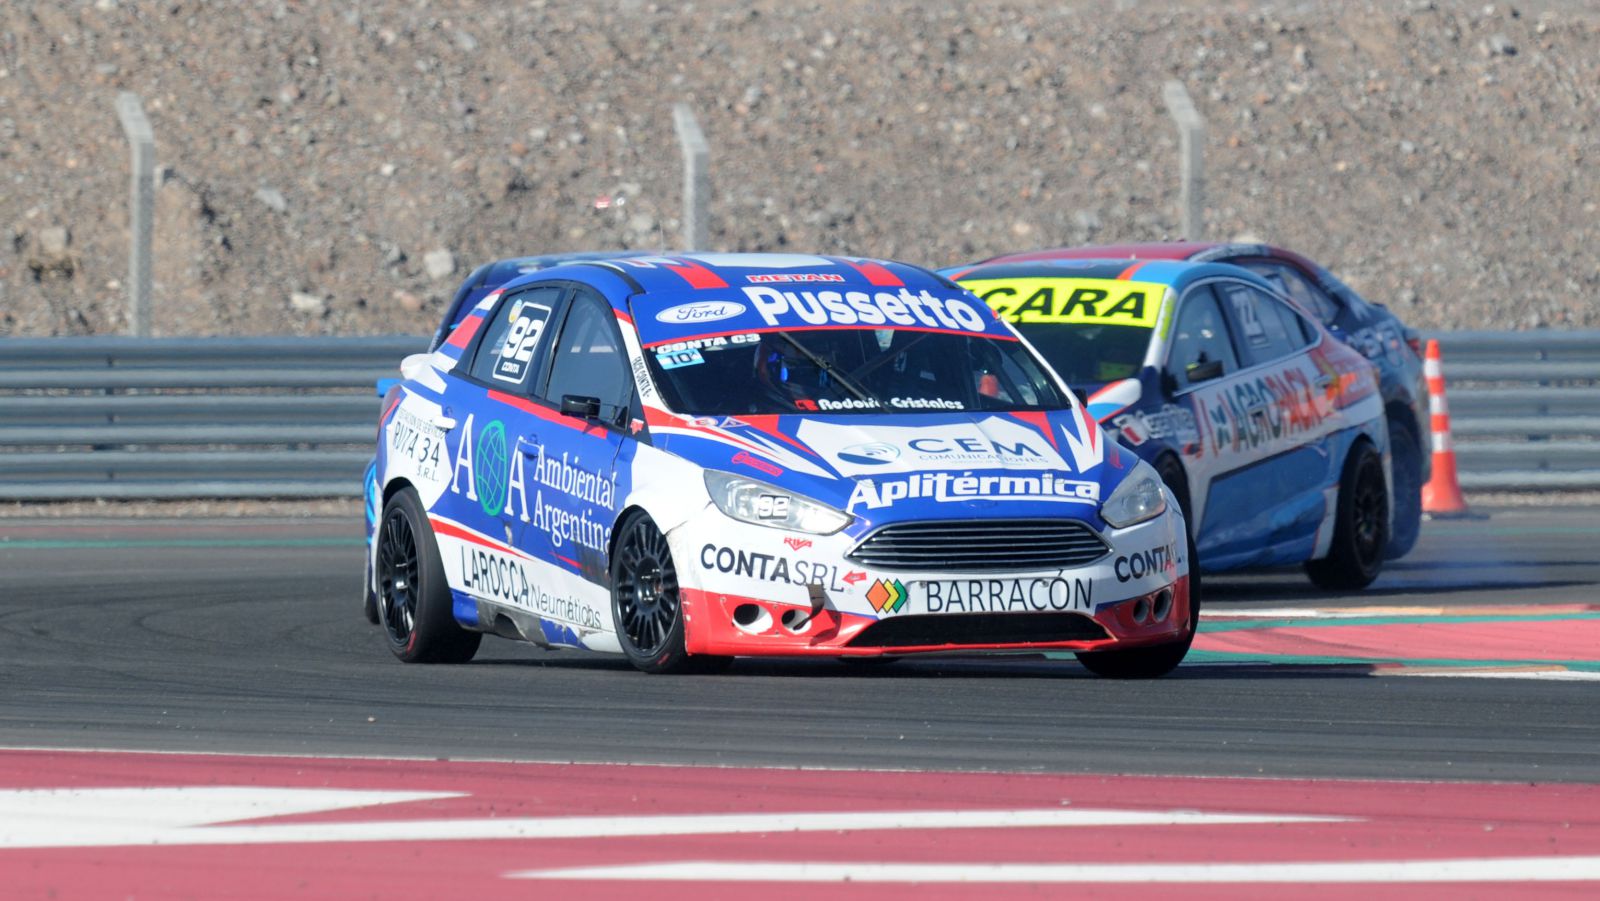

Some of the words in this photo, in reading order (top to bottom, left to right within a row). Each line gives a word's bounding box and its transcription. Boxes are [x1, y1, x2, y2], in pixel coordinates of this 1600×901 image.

[746, 273, 845, 284] METAN
[677, 301, 728, 320] Ford
[741, 286, 986, 332] Pussetto
[965, 287, 1146, 319] CARA
[502, 316, 544, 362] 92
[656, 336, 728, 354] CONTA
[731, 333, 761, 344] C3
[818, 398, 888, 410] Rodolf
[891, 397, 965, 410] Cristales
[419, 438, 440, 468] 34
[908, 438, 1043, 457] CEM
[918, 453, 1049, 464] COMUNICACIONES
[533, 445, 617, 511] Ambiental
[845, 471, 1100, 515] Aplitérmica
[533, 490, 611, 554] Argentina
[758, 496, 790, 519] 92
[784, 537, 814, 552] RIVA
[460, 546, 530, 606] LAROCCA
[530, 583, 602, 629] Neumáticos
[926, 570, 1094, 613] BARRACÓN
